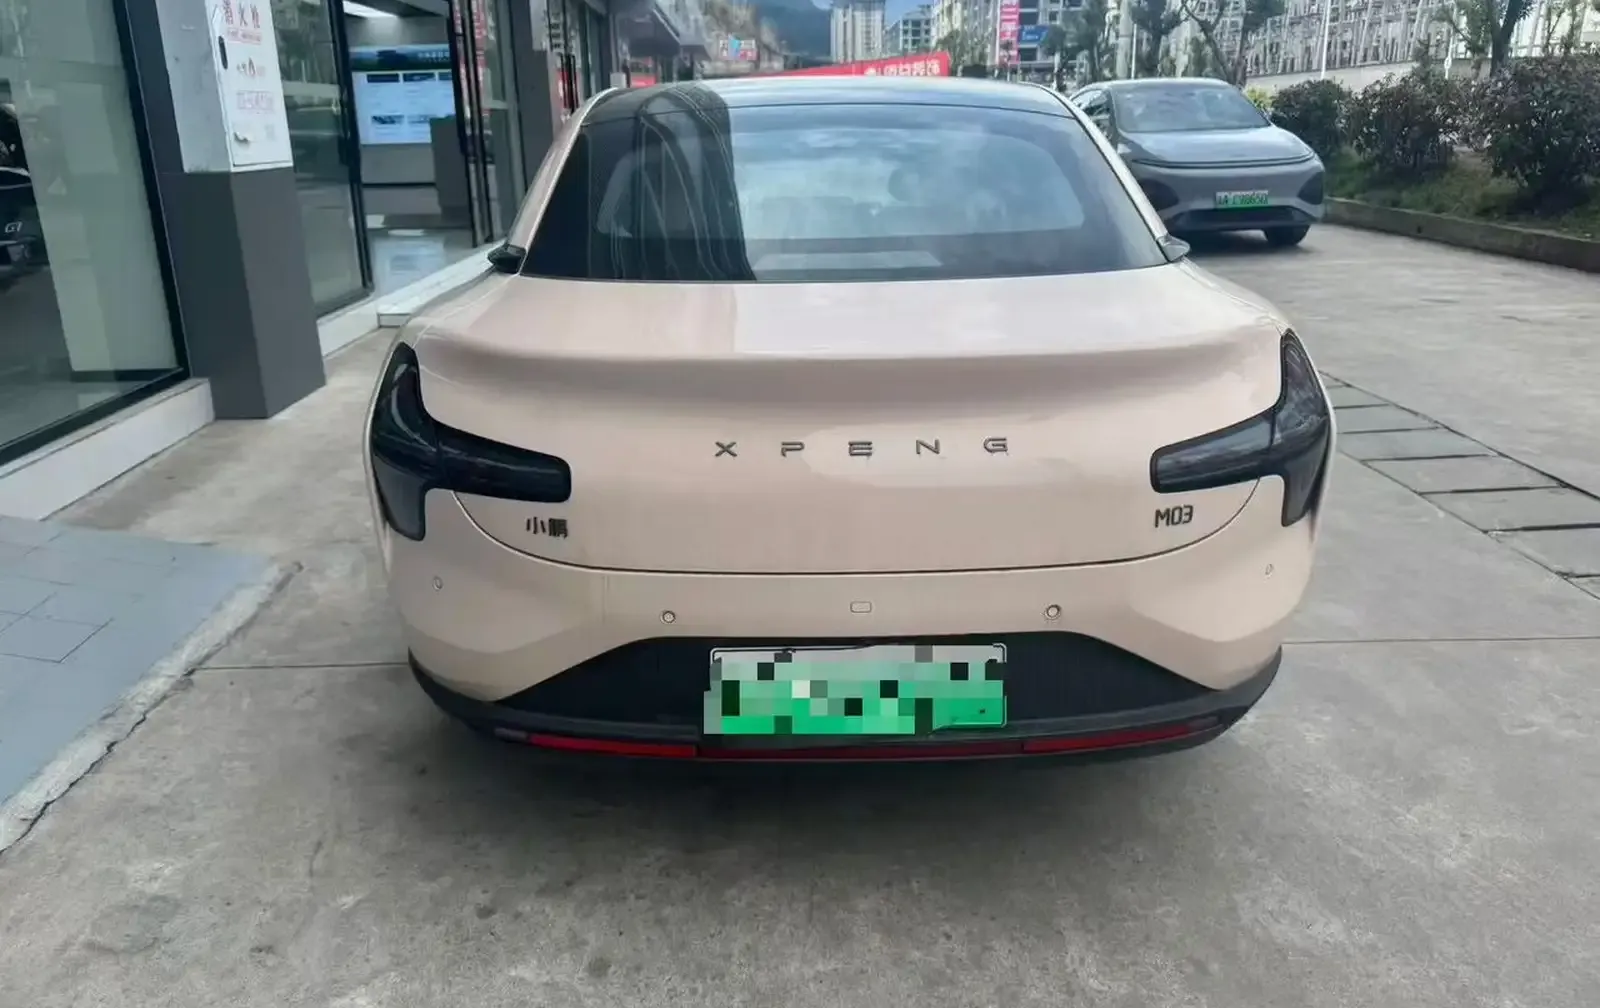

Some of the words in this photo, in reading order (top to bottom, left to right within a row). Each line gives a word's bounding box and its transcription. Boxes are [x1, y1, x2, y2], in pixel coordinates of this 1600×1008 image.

[714, 436, 1009, 458] XPENG
[525, 516, 569, 539] 小鹏
[1154, 504, 1194, 528] M03
